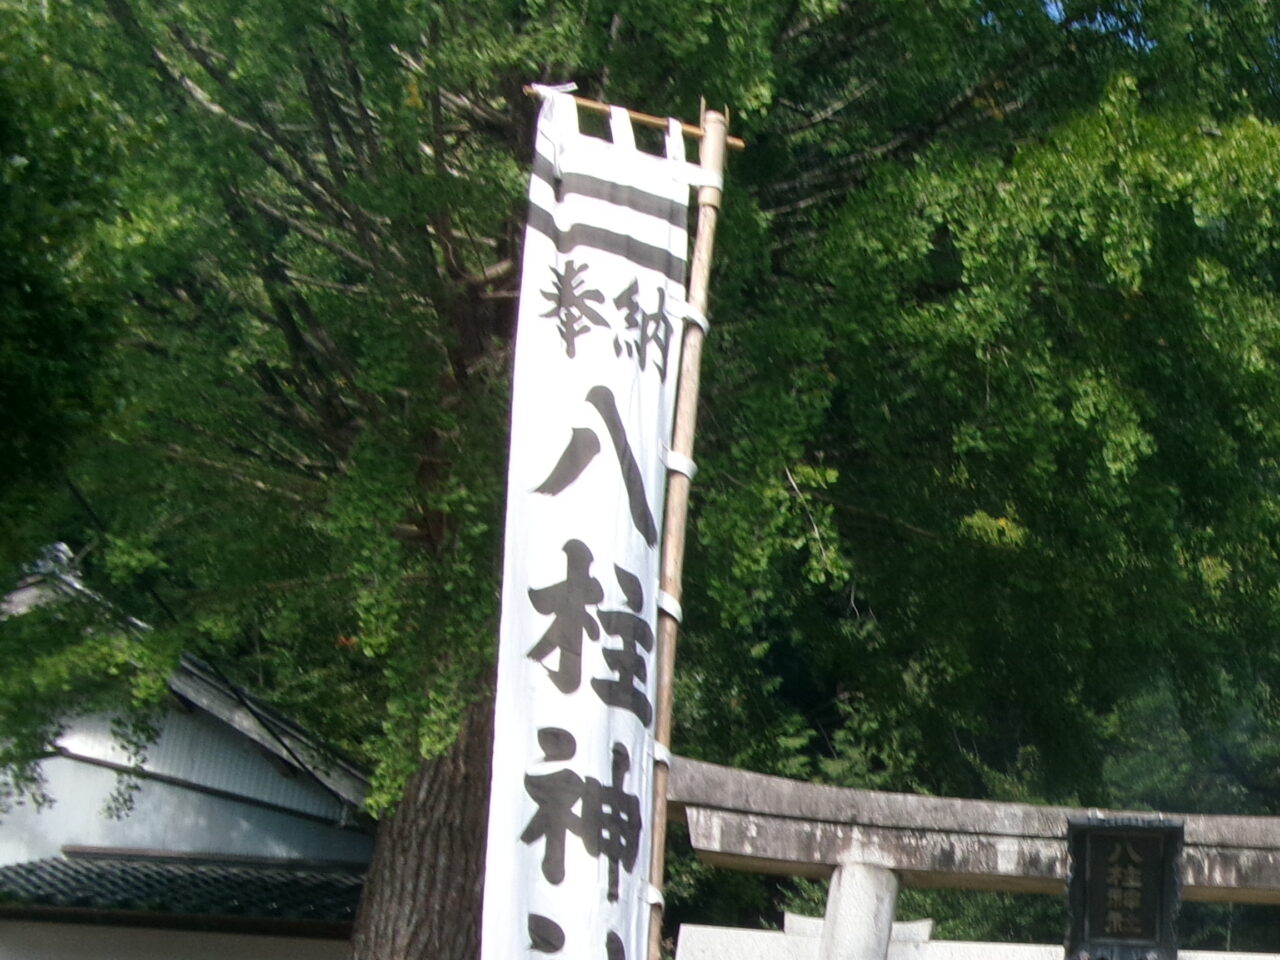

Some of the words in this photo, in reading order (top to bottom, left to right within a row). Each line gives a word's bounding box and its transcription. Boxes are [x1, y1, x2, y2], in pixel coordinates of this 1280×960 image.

[539, 260, 673, 384] 奉納
[1104, 842, 1143, 934] 八柱神社
